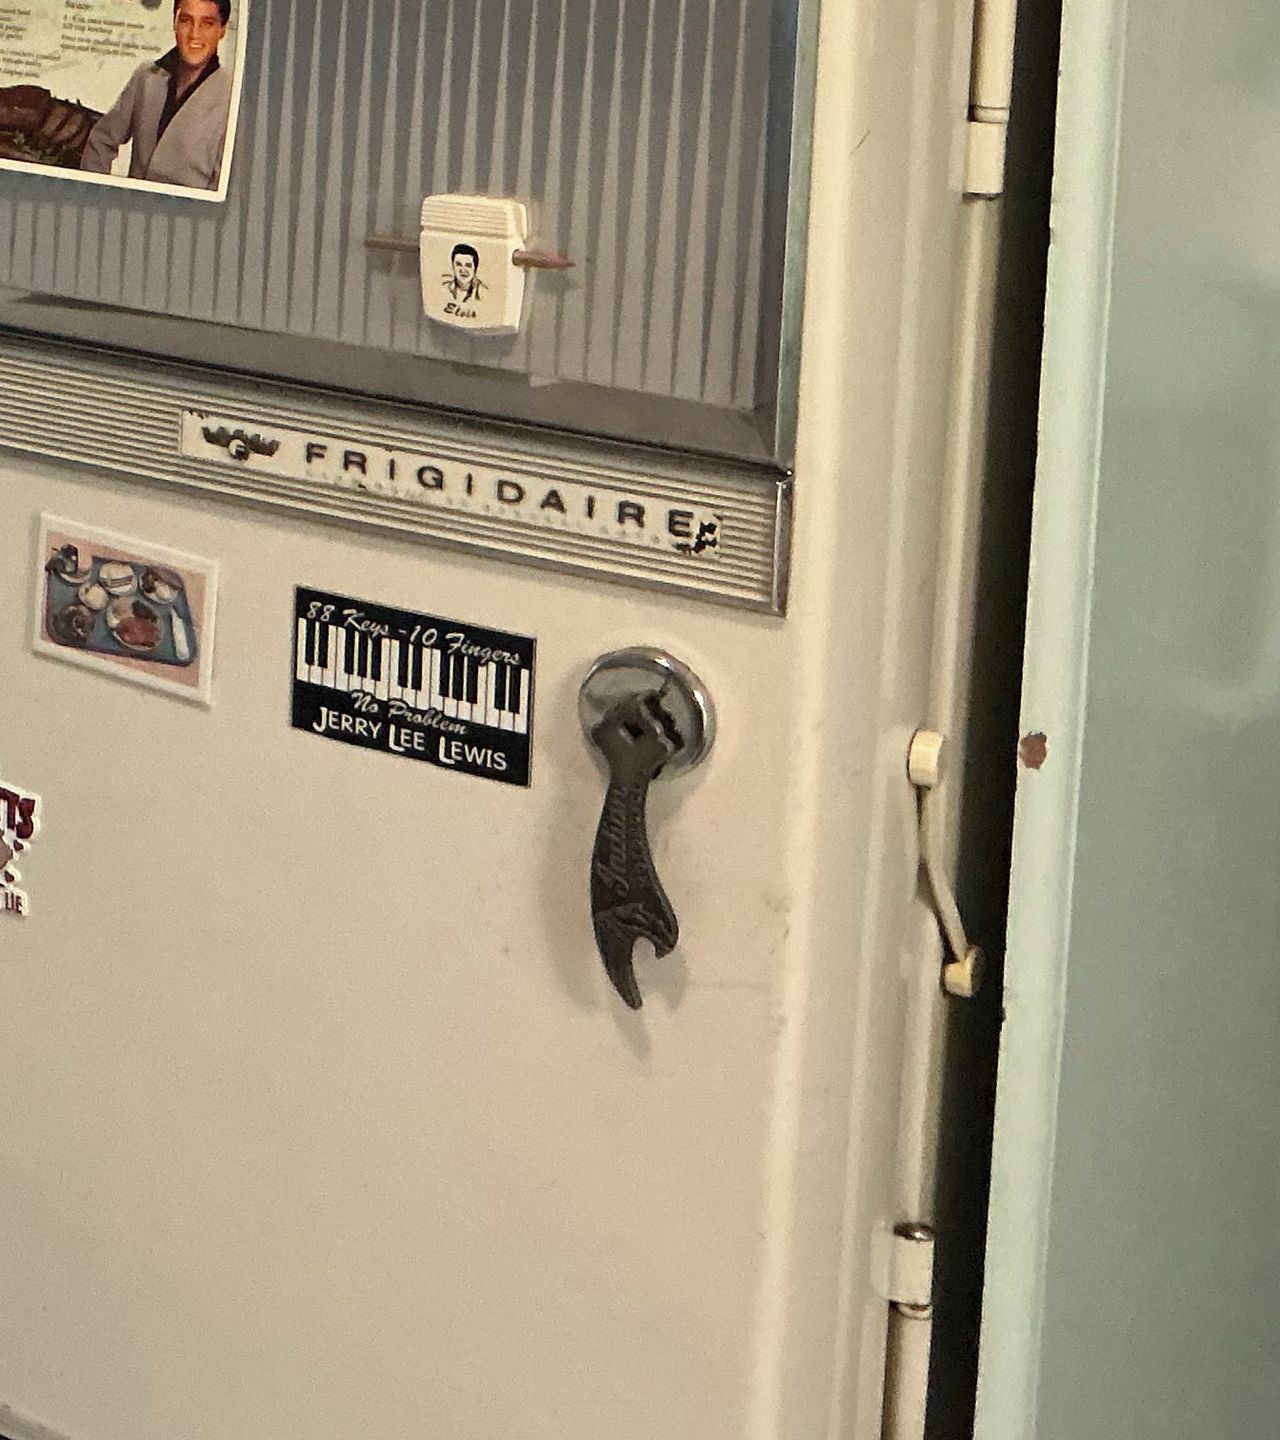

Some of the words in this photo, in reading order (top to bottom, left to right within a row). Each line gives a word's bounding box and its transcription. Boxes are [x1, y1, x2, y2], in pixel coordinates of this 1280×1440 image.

[443, 302, 477, 319] Elvis
[304, 441, 695, 537] FRIGIDAIRE
[306, 601, 335, 622] 88
[342, 608, 391, 638] Keys
[444, 632, 521, 665] Fingers
[312, 706, 383, 739] JERRY
[388, 723, 426, 752] LEE
[438, 736, 508, 771] LEWIS
[351, 691, 380, 714] No
[387, 699, 467, 736] Problem
[5, 891, 23, 914] LIE
